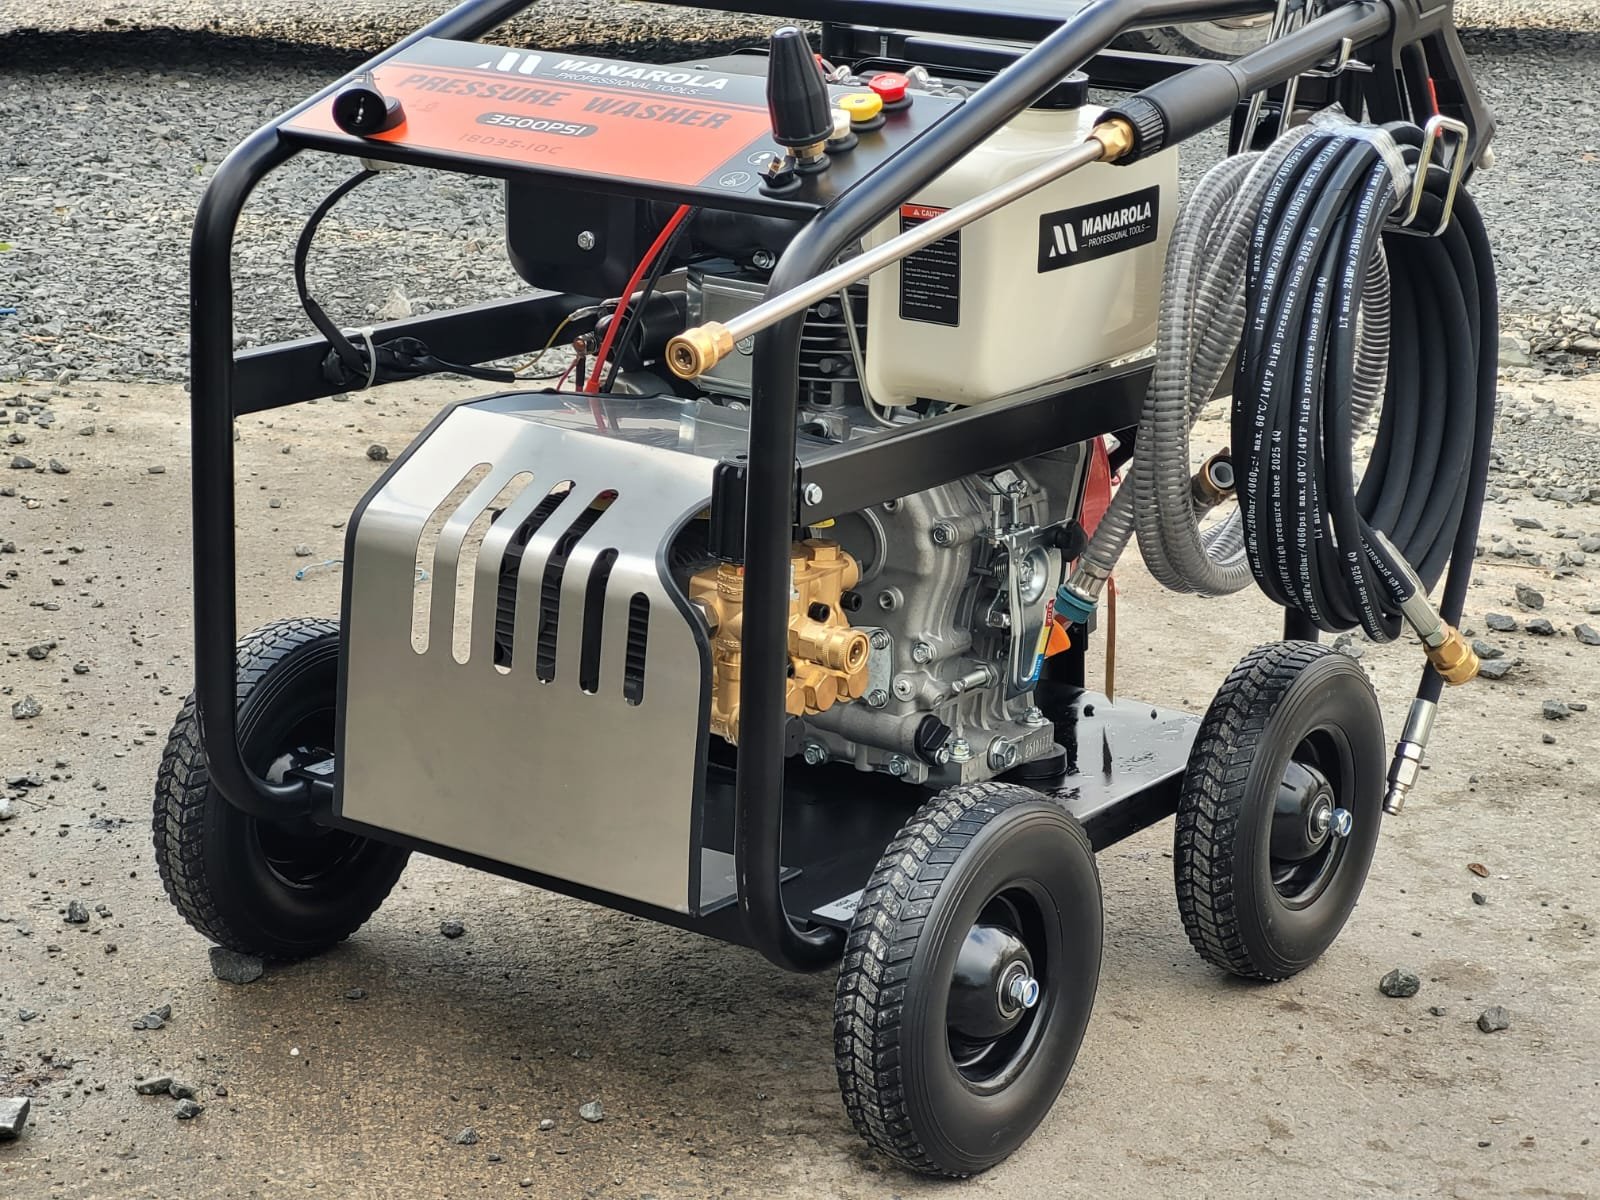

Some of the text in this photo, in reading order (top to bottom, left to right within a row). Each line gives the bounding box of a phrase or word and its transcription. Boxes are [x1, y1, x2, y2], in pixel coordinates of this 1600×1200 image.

[552, 58, 729, 90] MANAROLA
[555, 72, 699, 96] PROFESSIONAL TOOLS
[397, 73, 572, 107] PRESSURE
[582, 97, 733, 129] WASHER
[486, 114, 588, 136] 3500PSI
[1081, 201, 1151, 237] MANAROLA
[1088, 223, 1145, 248] PROFESSIONAL TOOLS
[1316, 276, 1328, 287] 4Q
[1267, 342, 1281, 367] high
[1276, 291, 1296, 339] pressure
[1289, 265, 1304, 288] hose
[1298, 240, 1314, 262] 2025
[1309, 226, 1320, 238] 4Q
[1311, 290, 1325, 314] 2025
[1307, 318, 1320, 342] hose
[1303, 345, 1316, 394] pressure
[1299, 397, 1311, 423] high
[1271, 430, 1282, 443] 4Q
[1271, 446, 1281, 471] 2025
[1271, 474, 1281, 498] hose
[1273, 501, 1285, 543] pressure
[1347, 551, 1358, 562] 4Q
[1362, 543, 1392, 577] pressure
[1350, 565, 1364, 585] 2025
[1388, 576, 1405, 596] high
[1359, 586, 1369, 605] hose
